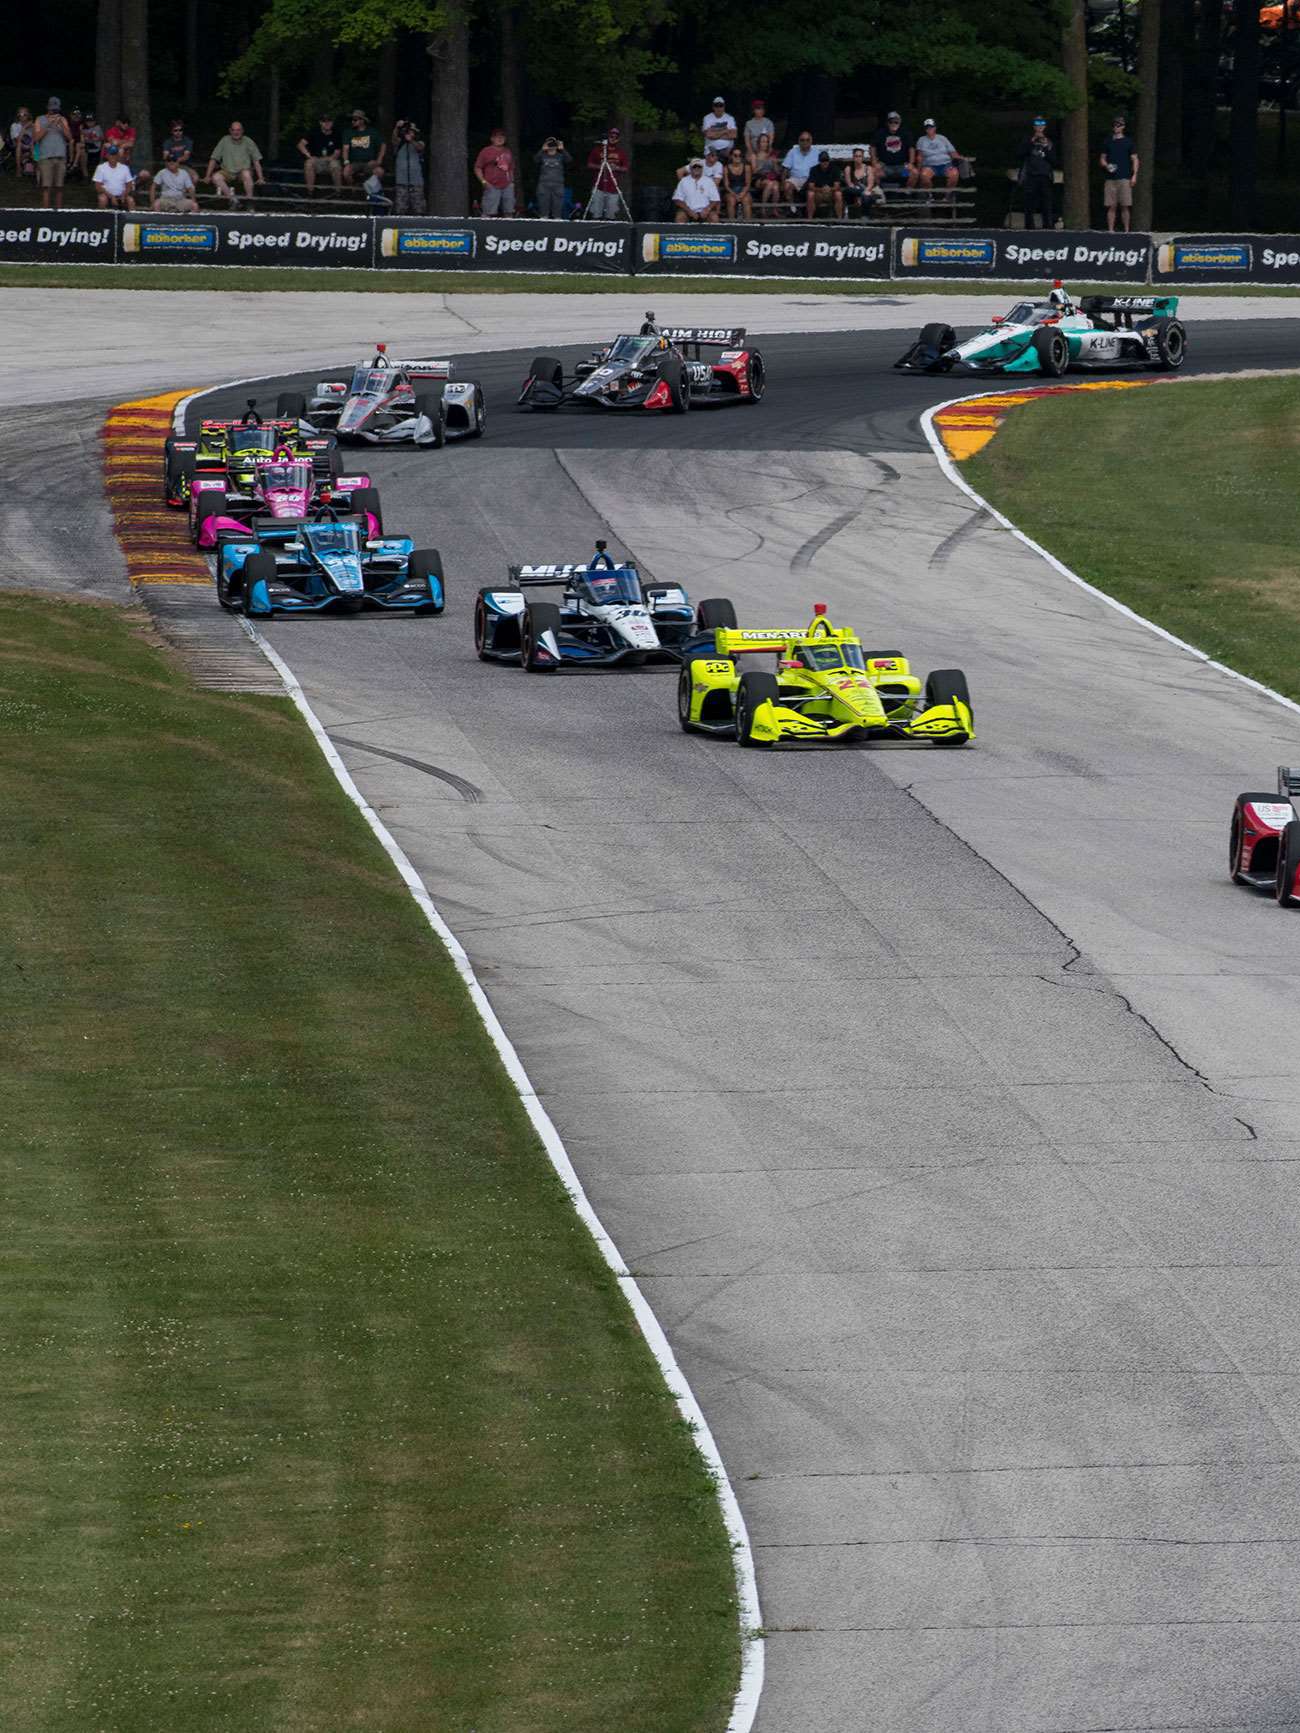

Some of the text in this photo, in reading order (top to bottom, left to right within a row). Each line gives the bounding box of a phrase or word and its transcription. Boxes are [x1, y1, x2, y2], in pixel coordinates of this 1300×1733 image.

[37, 227, 110, 245] Drying!
[146, 233, 207, 243] absorber
[227, 230, 367, 251] Speed Drying!
[404, 238, 465, 248] absorber
[485, 235, 625, 257] Speed Drying!
[665, 243, 726, 253] absorber
[745, 239, 884, 261] Speed Drying!
[924, 246, 985, 258] absorber
[1005, 244, 1146, 264] Speed Drying!
[1180, 252, 1242, 264] absorber
[662, 329, 693, 338] AIM
